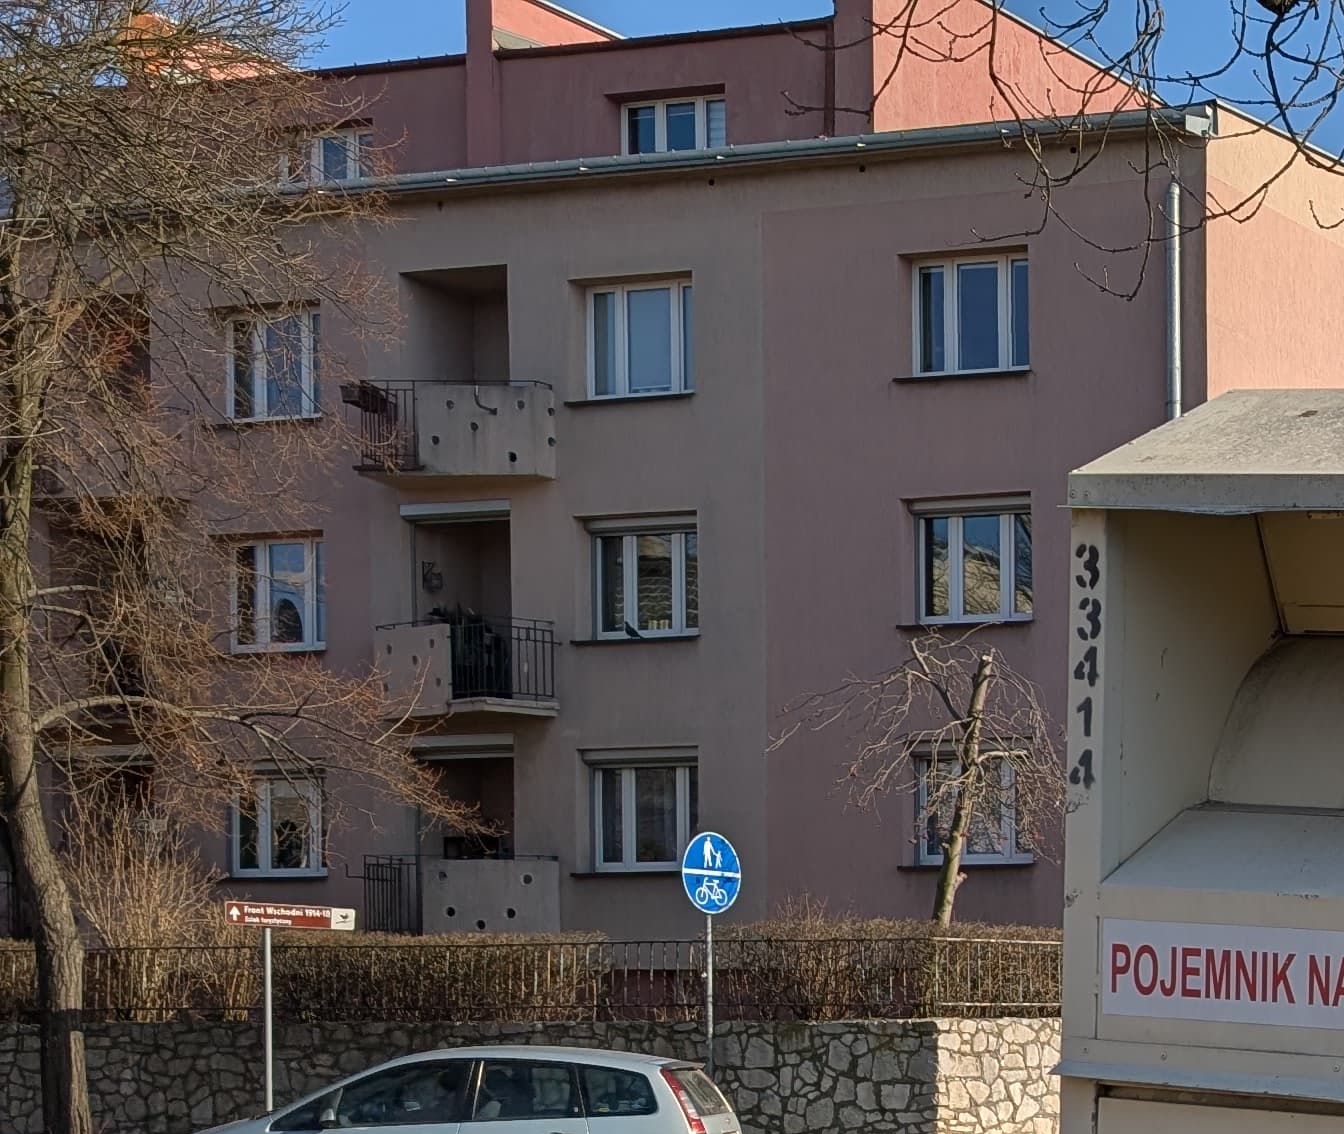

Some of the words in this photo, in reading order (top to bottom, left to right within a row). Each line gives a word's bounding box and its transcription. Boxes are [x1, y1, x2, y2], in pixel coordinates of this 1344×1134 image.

[1069, 543, 1101, 790] 33414
[244, 905, 264, 915] Front
[1110, 943, 1296, 1004] POJEMNIK
